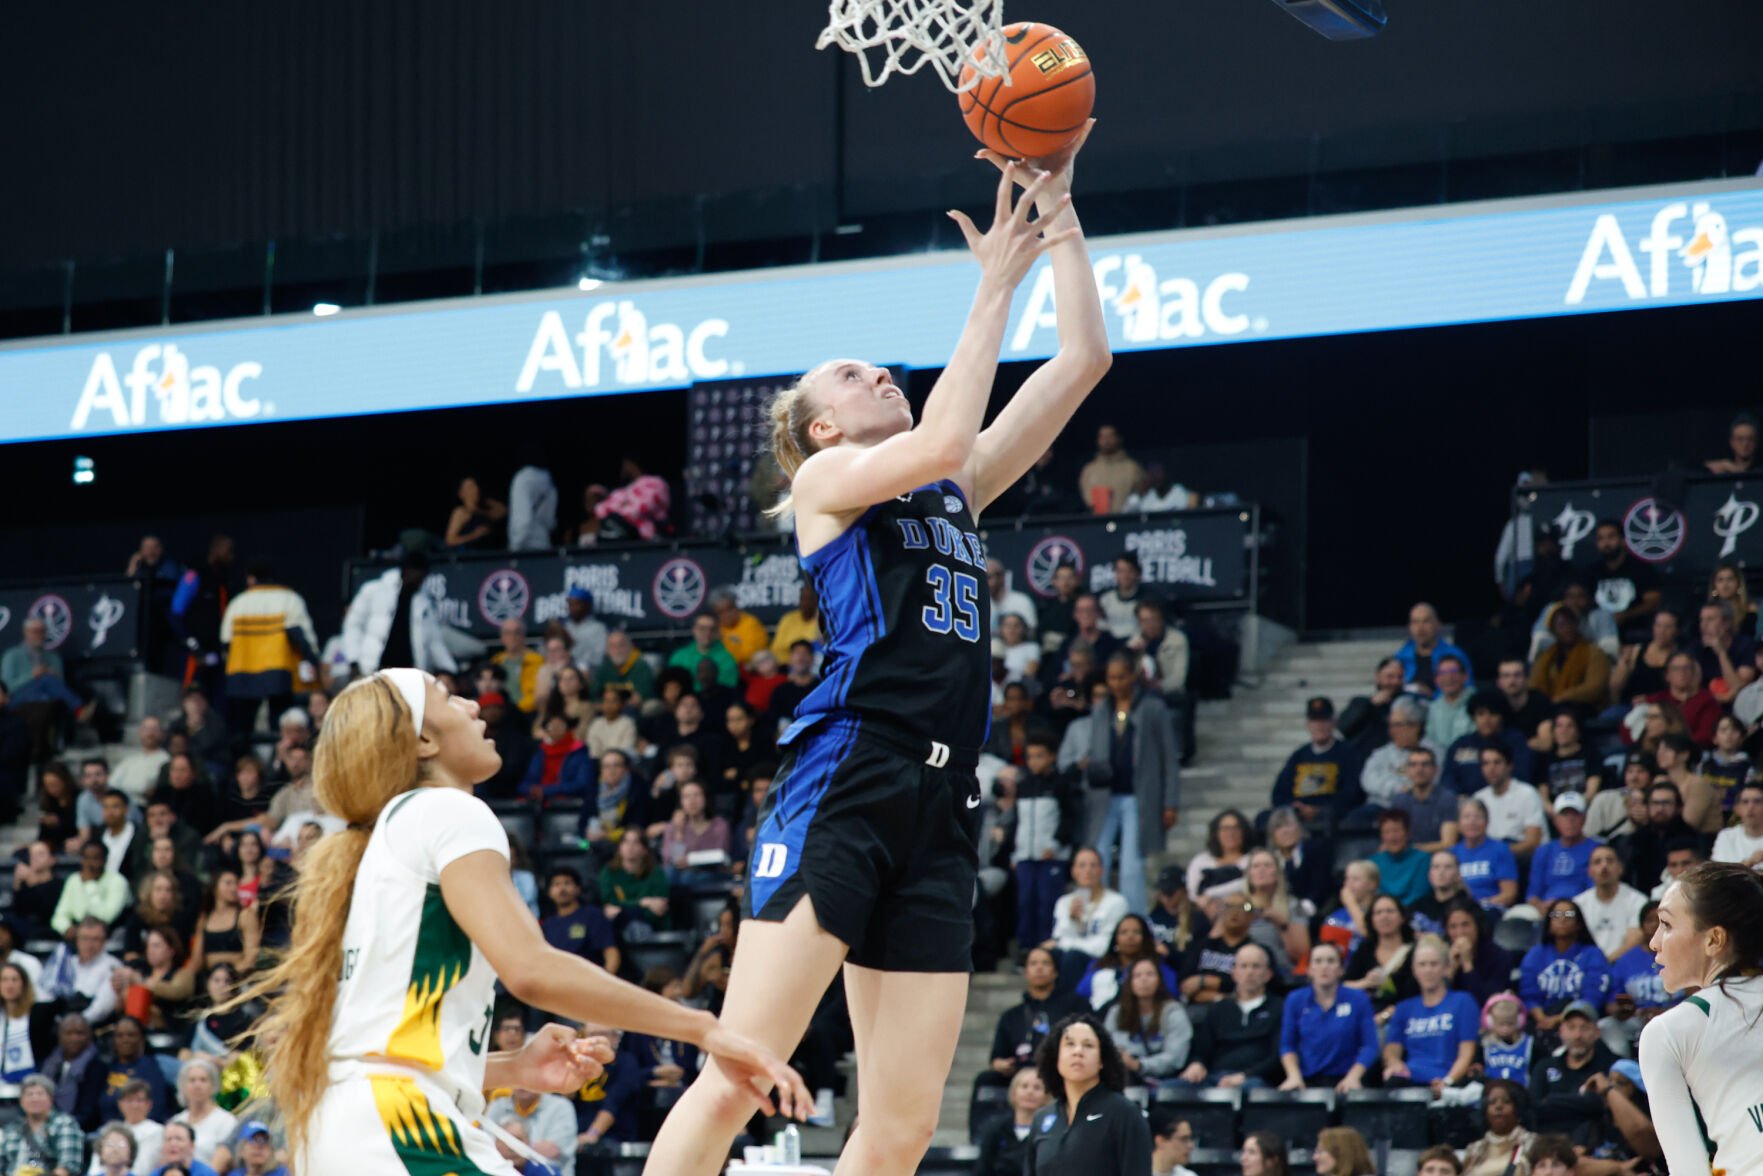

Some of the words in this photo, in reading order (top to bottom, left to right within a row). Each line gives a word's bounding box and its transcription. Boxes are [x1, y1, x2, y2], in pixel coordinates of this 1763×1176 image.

[515, 300, 730, 393] Aflac
[70, 343, 263, 431] Aflac
[898, 517, 988, 572] DUKE
[922, 563, 980, 643] 35
[925, 741, 950, 768] D
[755, 843, 788, 878] D
